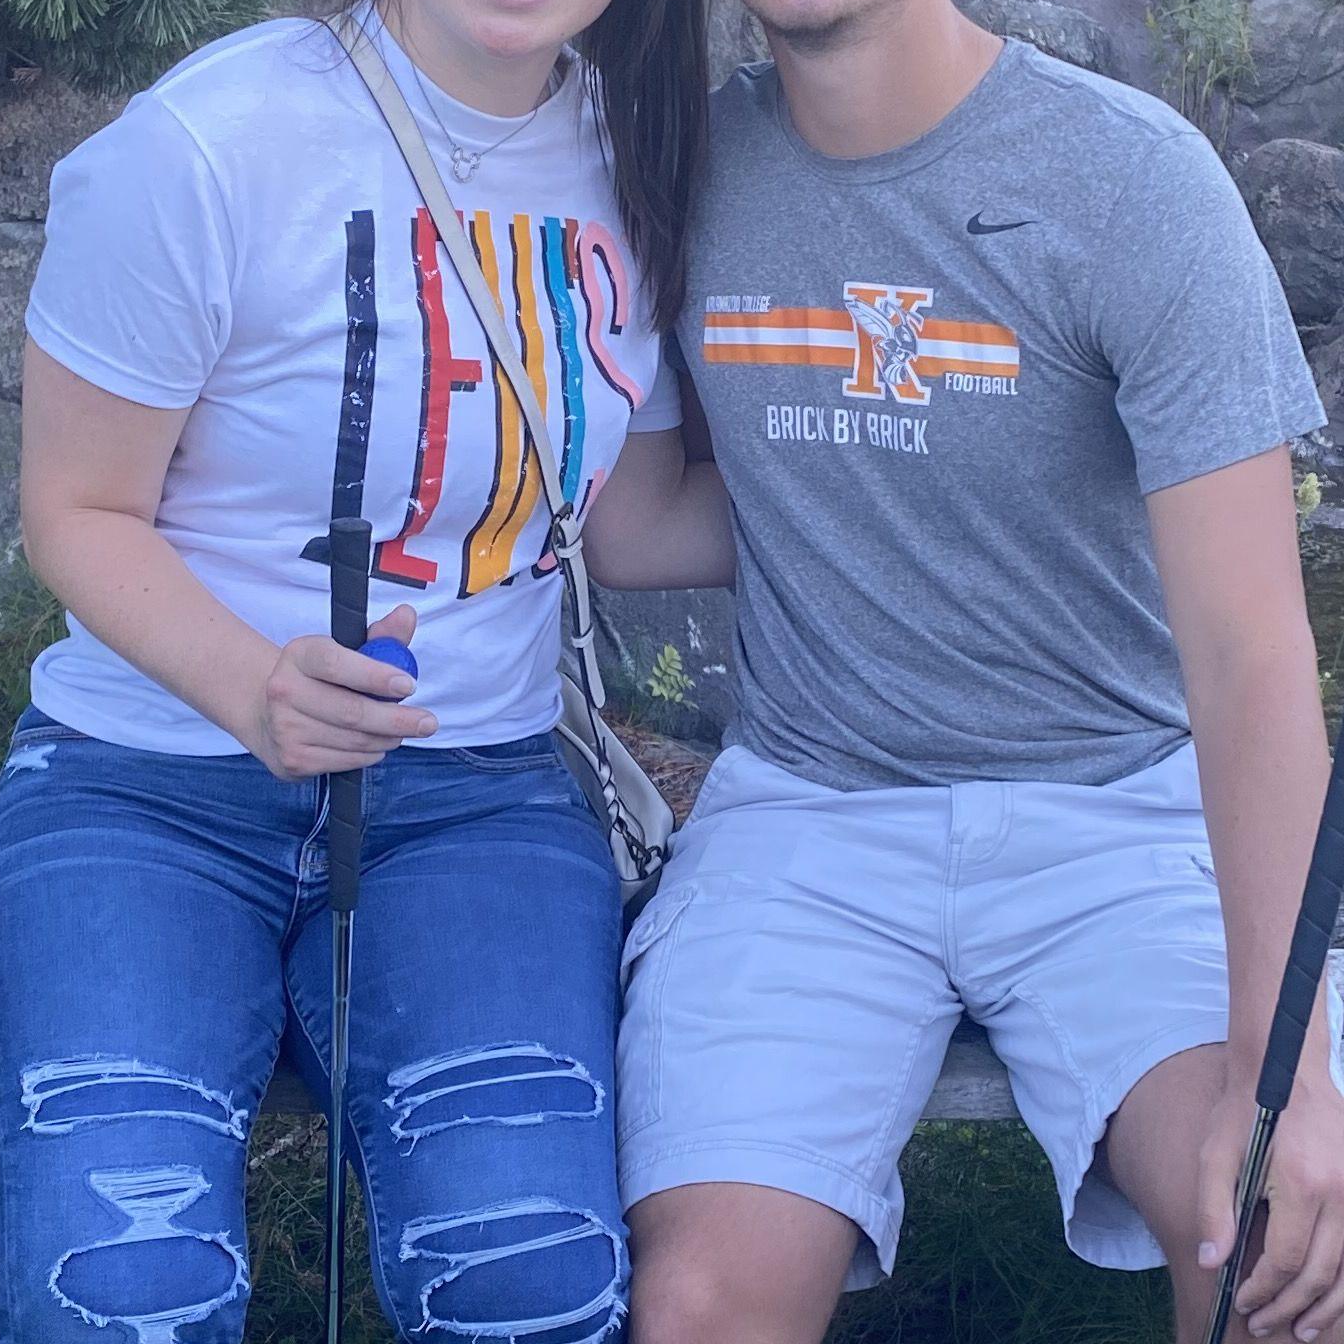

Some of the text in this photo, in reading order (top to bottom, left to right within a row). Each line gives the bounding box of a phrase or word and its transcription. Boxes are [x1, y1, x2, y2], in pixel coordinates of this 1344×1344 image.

[841, 281, 935, 406] K
[945, 372, 1019, 396] FOOTBALL
[766, 404, 930, 455] BRICK BY BRICK
